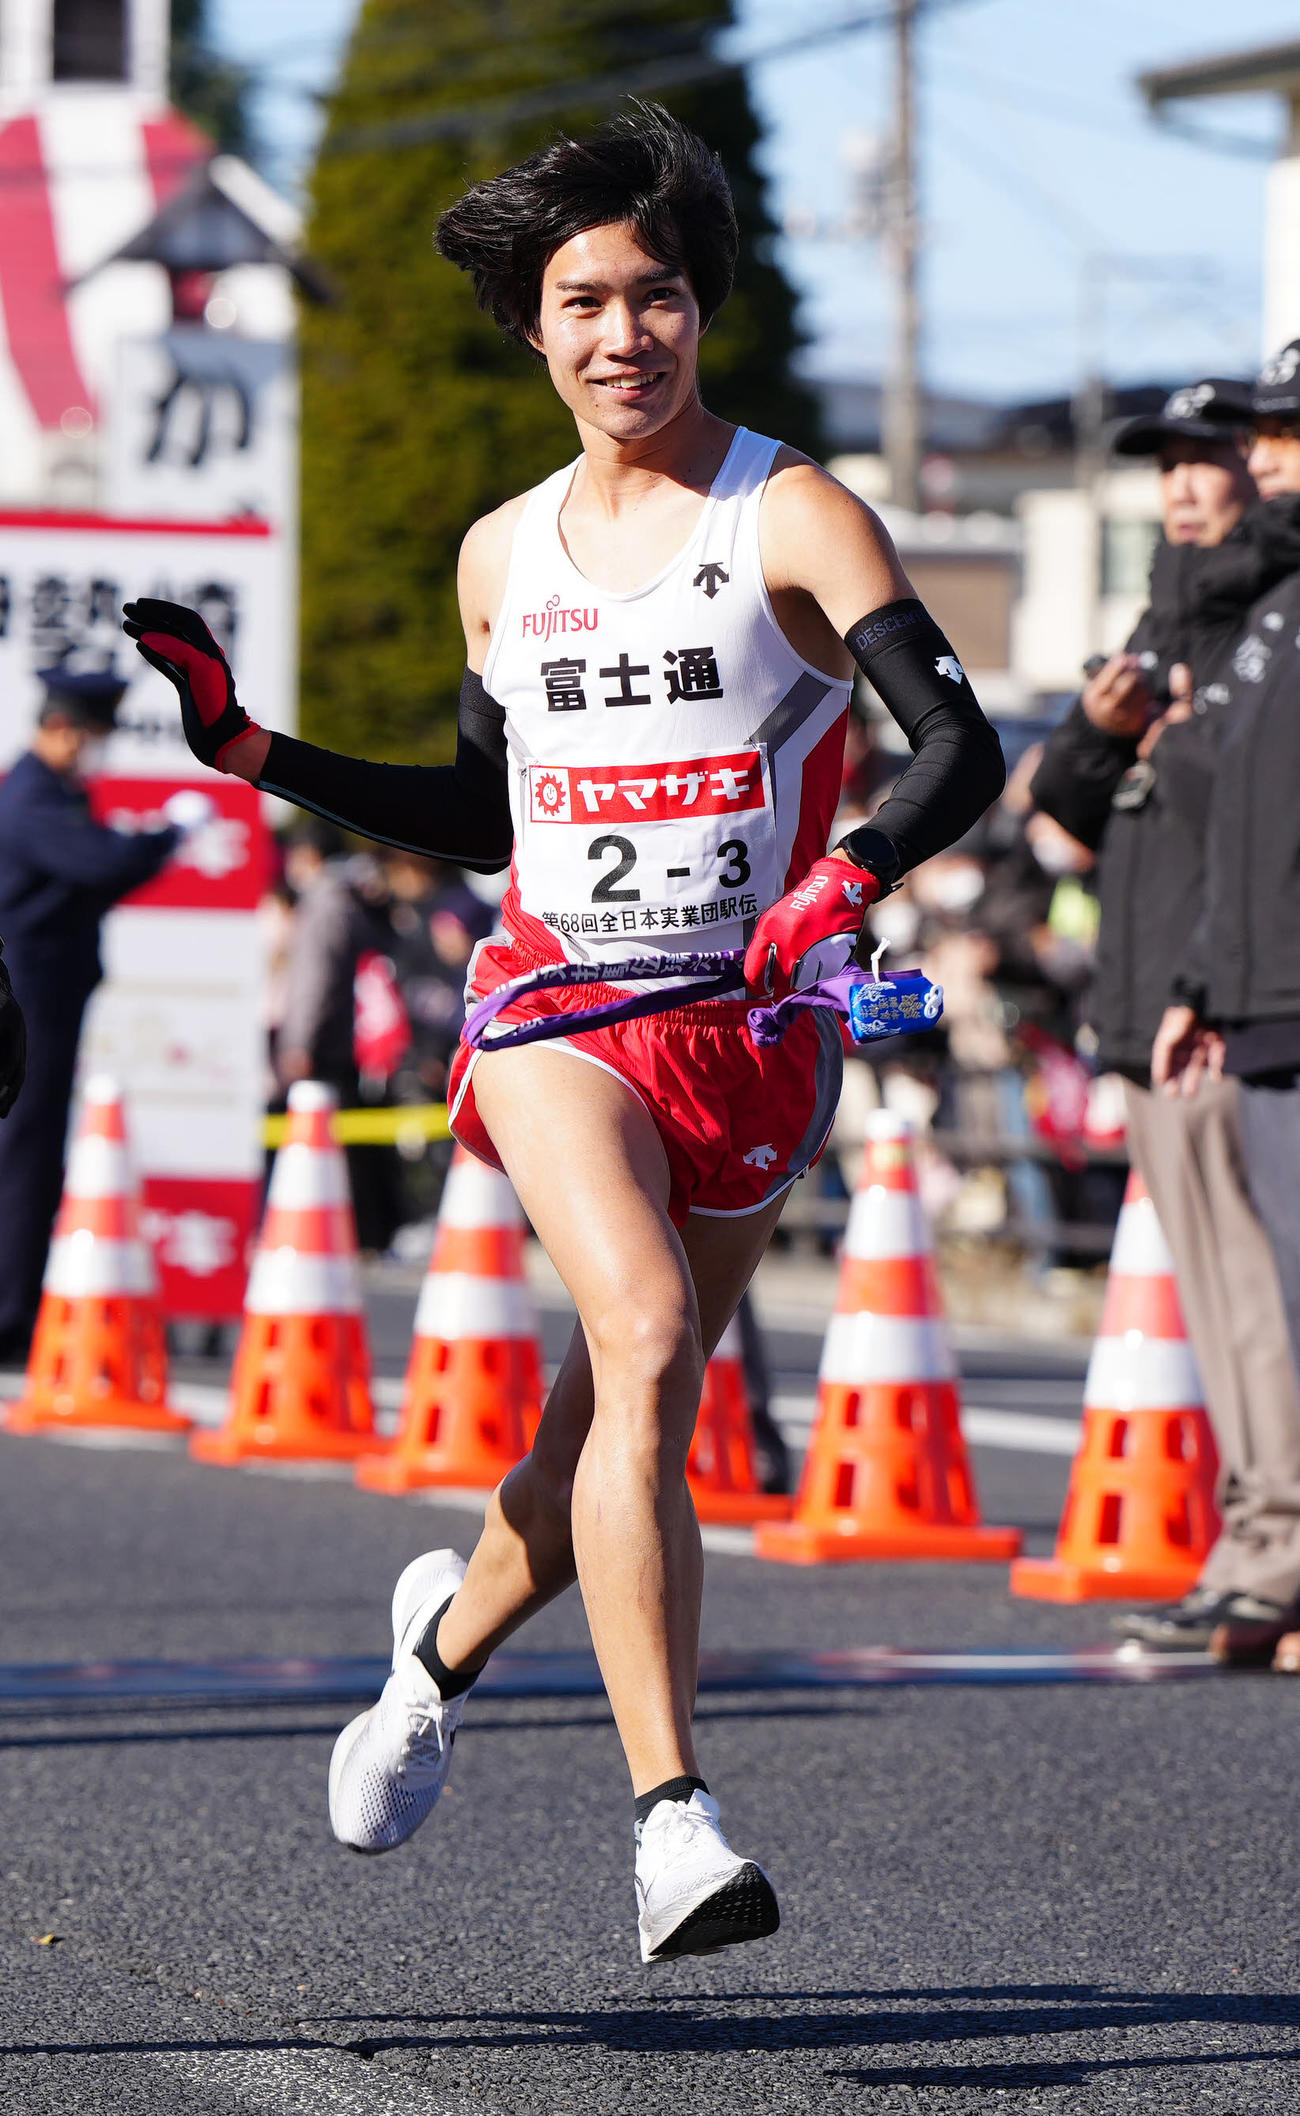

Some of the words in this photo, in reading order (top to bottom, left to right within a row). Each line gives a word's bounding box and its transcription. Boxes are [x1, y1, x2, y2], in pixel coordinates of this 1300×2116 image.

[521, 594, 599, 642] FUJITSU
[540, 646, 725, 712] 富士通
[576, 767, 750, 813] ヤマザキ
[541, 892, 758, 934] 第68回全日本実業団駅伝
[790, 874, 829, 911] FUJITSU
